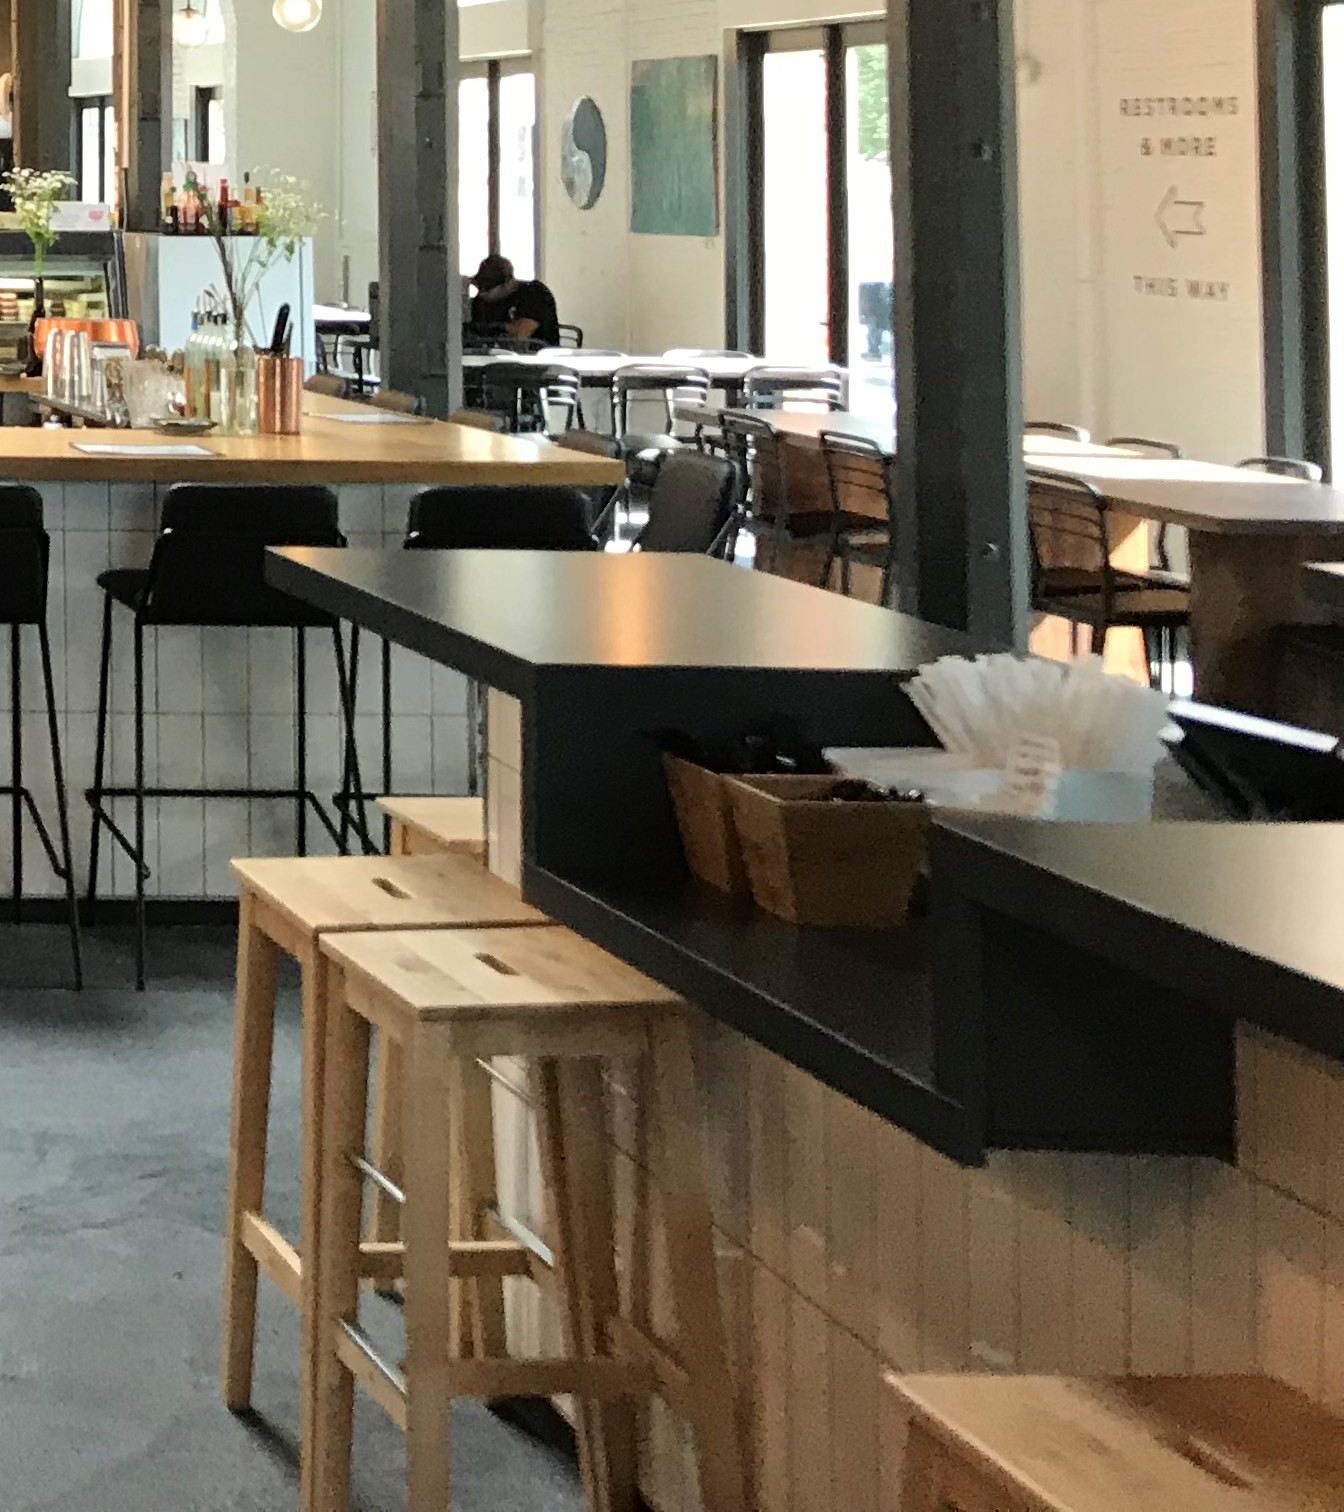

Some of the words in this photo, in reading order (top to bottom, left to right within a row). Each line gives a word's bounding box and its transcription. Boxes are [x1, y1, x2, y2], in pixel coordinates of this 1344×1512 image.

[1120, 97, 1238, 116] RESTROOMS
[1140, 137, 1152, 156] &
[1160, 137, 1217, 156] MORE
[1133, 275, 1178, 297] THIS
[1185, 278, 1230, 301] WAY
